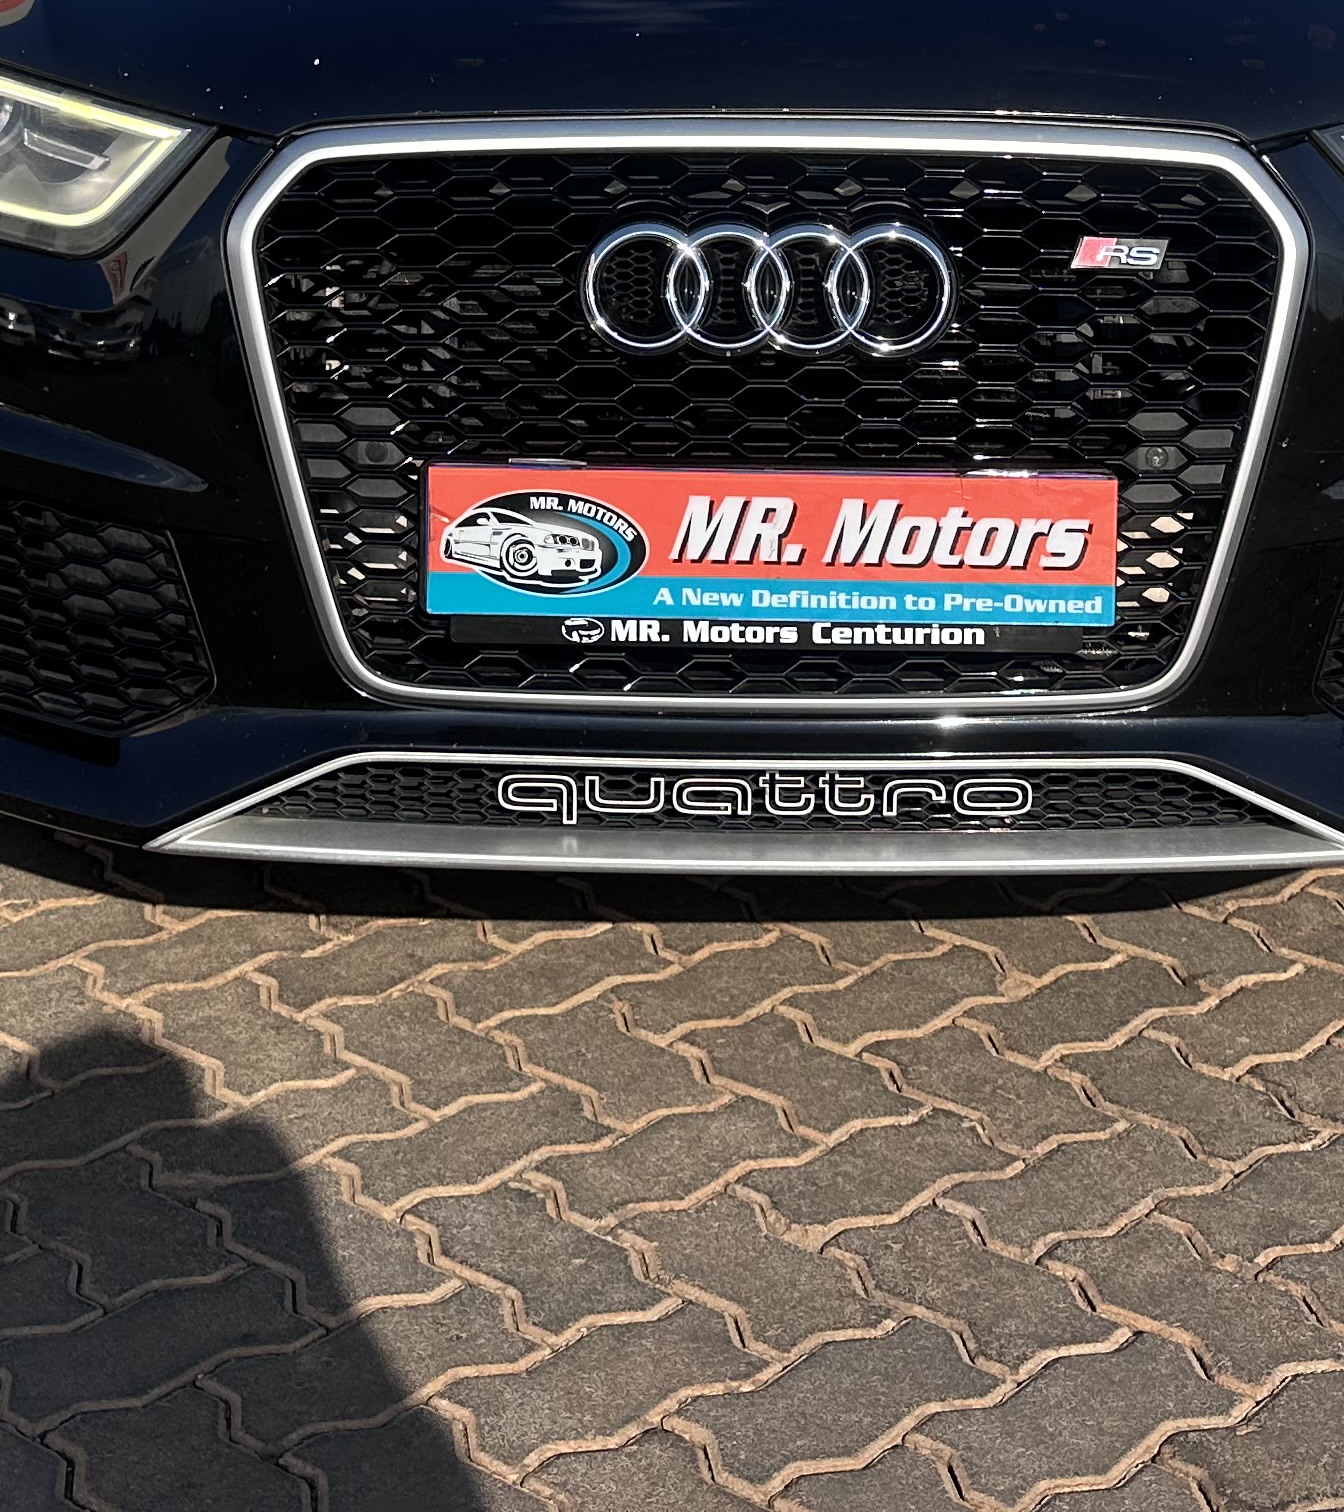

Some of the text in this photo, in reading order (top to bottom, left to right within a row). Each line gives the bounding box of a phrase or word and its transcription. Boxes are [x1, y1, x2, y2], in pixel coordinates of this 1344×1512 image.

[1095, 244, 1161, 267] RS
[529, 495, 638, 542] MR. MOTORS
[670, 495, 1092, 570] MR. Motors
[652, 587, 1104, 615] A New Definition to Pre-Owned
[610, 620, 986, 646] MR. Motors Centurion
[497, 773, 1034, 825] quattro
